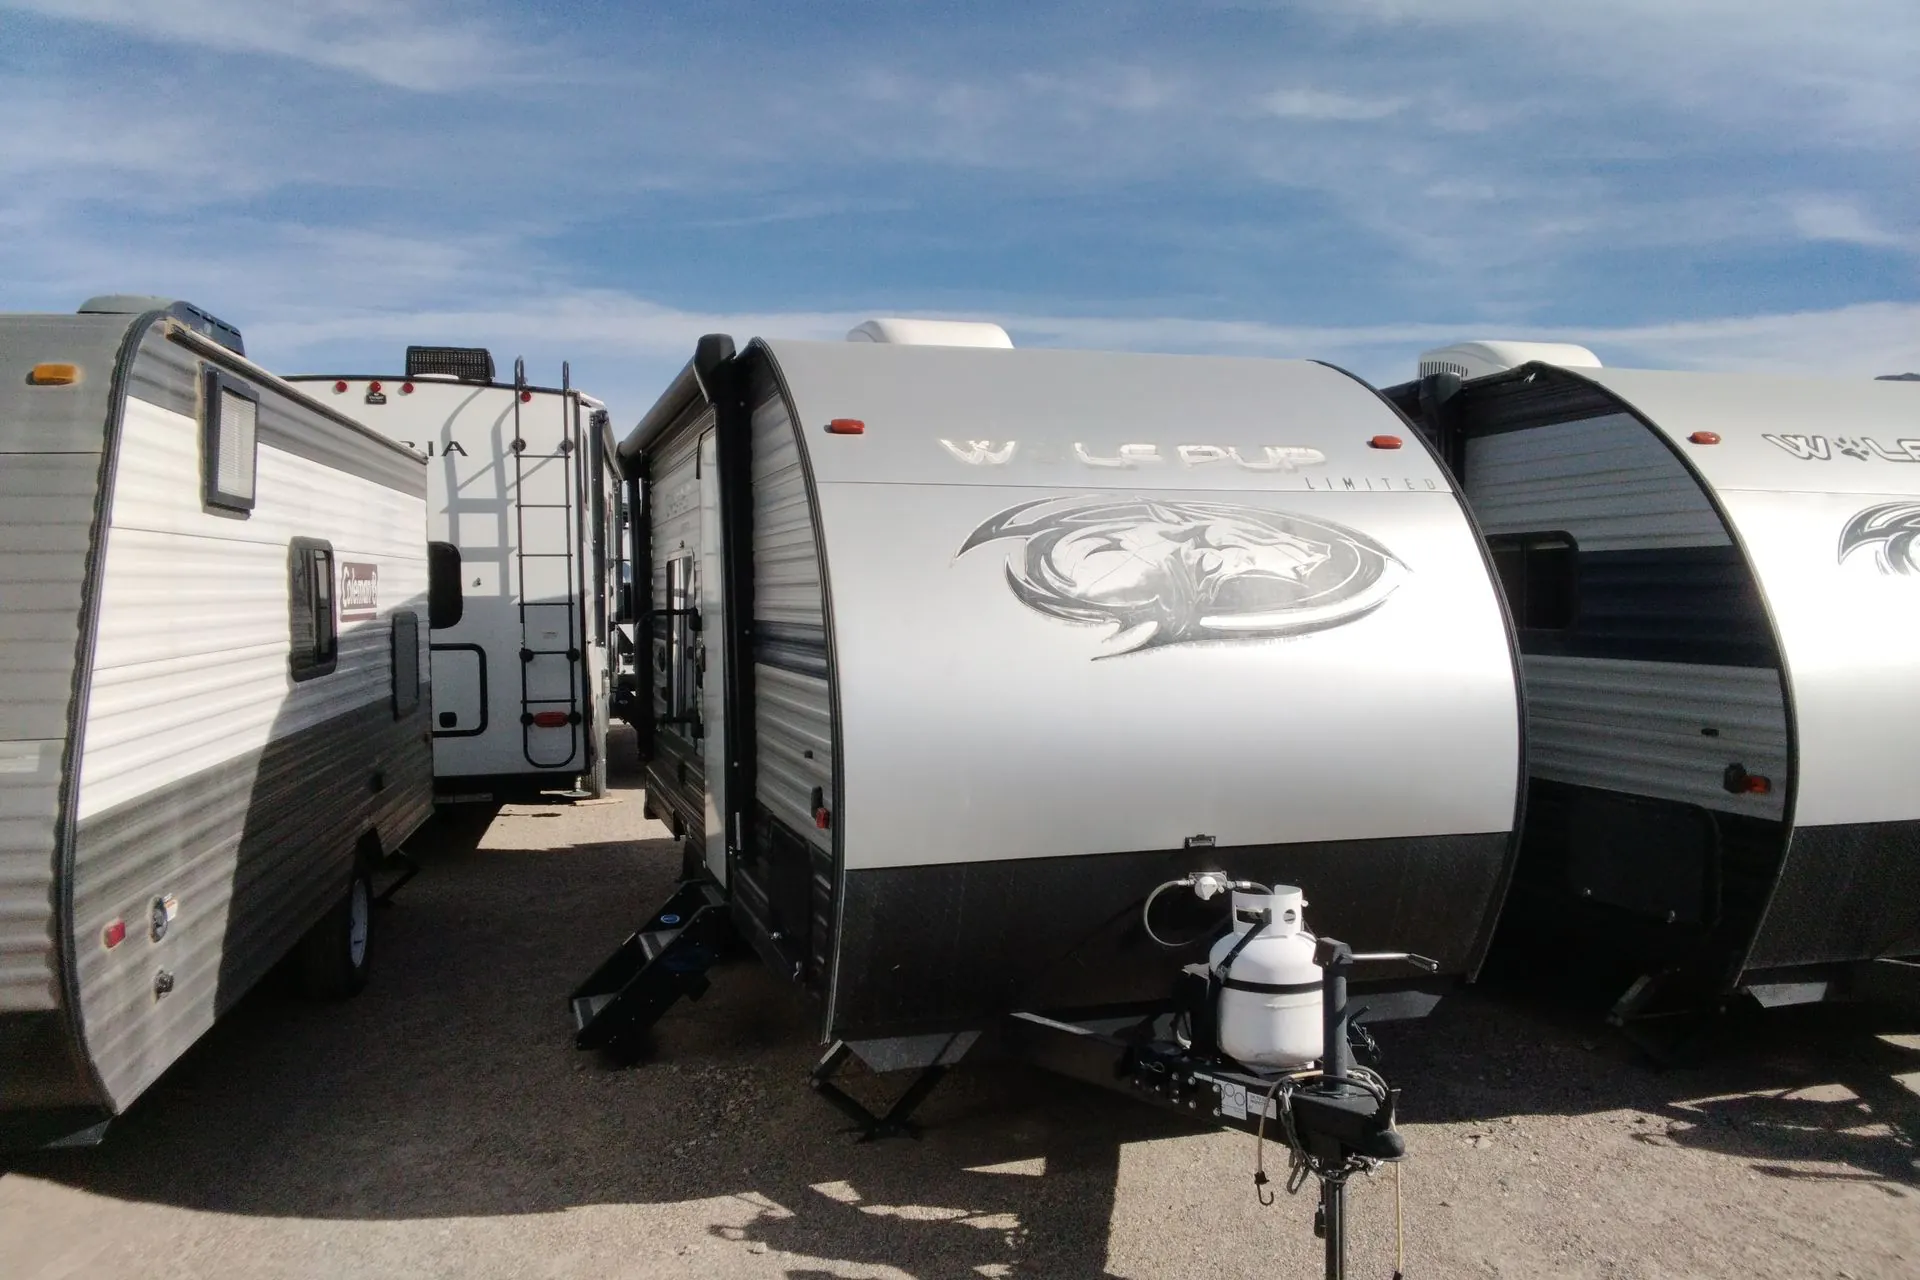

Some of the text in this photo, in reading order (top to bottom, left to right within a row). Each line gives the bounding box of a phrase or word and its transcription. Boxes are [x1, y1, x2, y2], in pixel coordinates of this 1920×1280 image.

[940, 438, 1163, 468] WLF
[1305, 476, 1437, 491] LIMITED
[342, 566, 373, 608] Coleman
